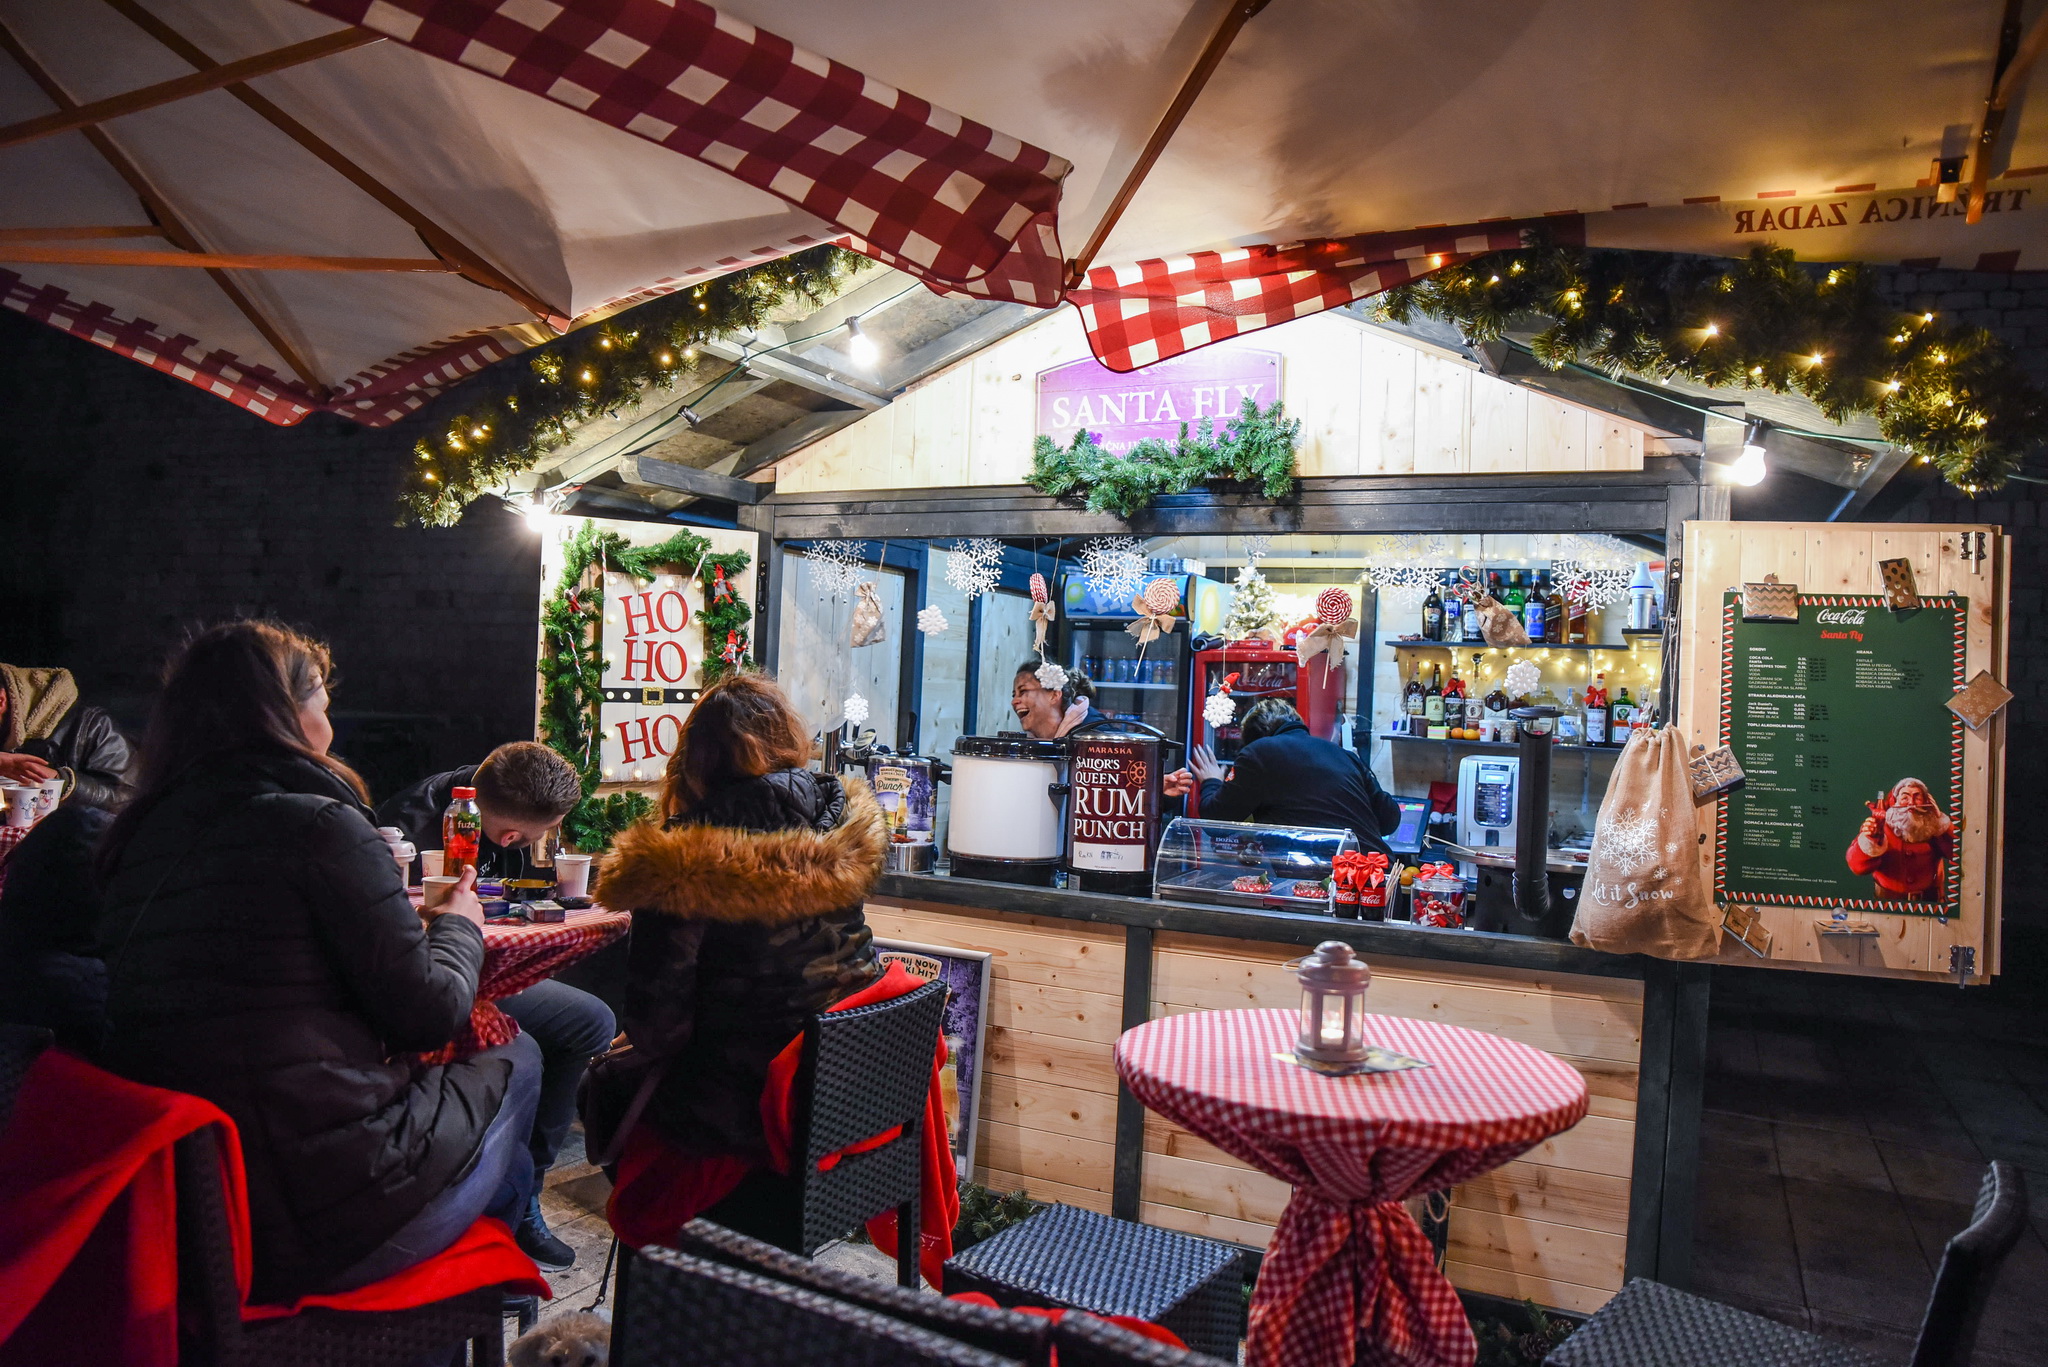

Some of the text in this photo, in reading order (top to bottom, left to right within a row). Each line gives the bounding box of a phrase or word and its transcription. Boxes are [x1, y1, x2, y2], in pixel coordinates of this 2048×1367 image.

[1052, 384, 1264, 428] SANTA FLY
[618, 590, 689, 638] HO
[1816, 608, 1868, 624] Coca-Cola
[1820, 630, 1864, 642] Santa Fly
[621, 638, 688, 683] HO
[615, 714, 683, 764] HO
[1076, 756, 1120, 771] SAILOR'S
[1075, 771, 1120, 786] QUEEN
[1074, 786, 1146, 817] RUM
[1074, 818, 1144, 839] PUNCH
[1592, 878, 1673, 909] Let it Snow
[916, 959, 938, 970] NOVI
[918, 969, 935, 979] HIT
